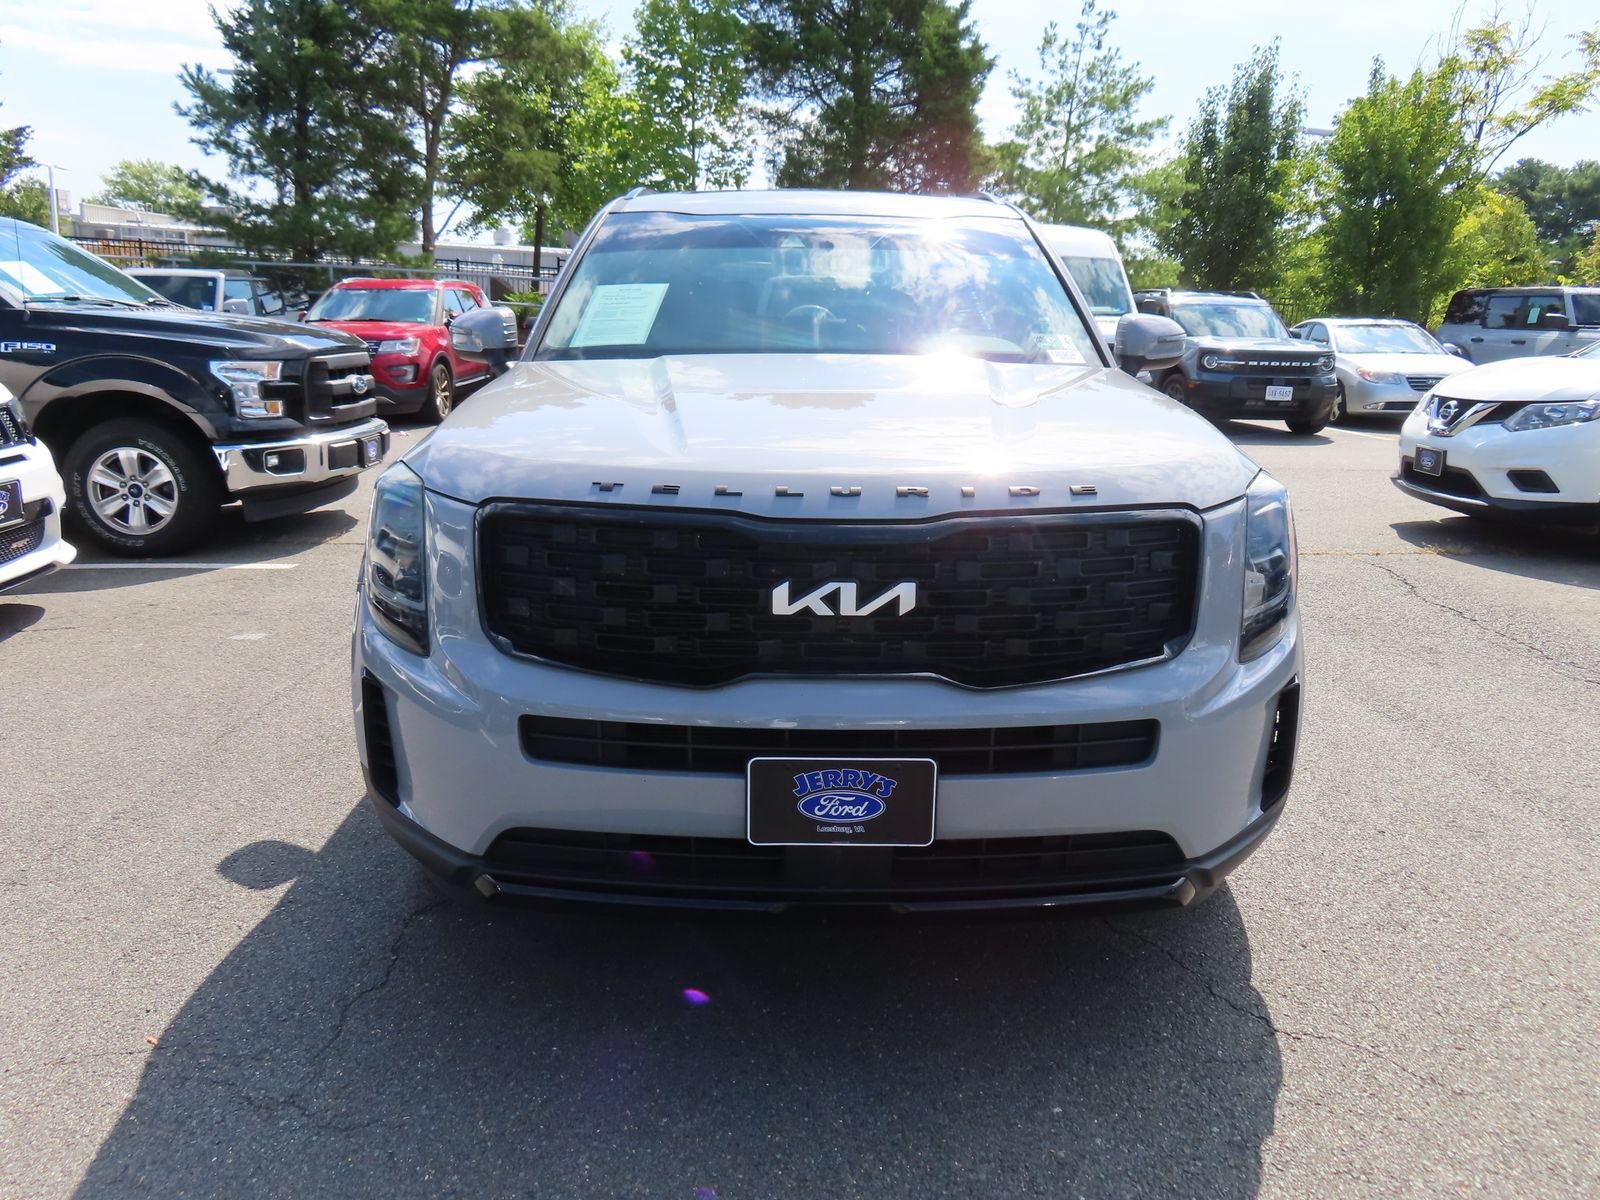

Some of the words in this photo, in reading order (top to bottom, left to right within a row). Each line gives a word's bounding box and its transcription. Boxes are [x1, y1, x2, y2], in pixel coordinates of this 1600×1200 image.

[591, 481, 1098, 498] TELLURIDE
[771, 580, 918, 617] KIA
[792, 768, 898, 798] JERRY'S
[814, 795, 870, 817] Ford
